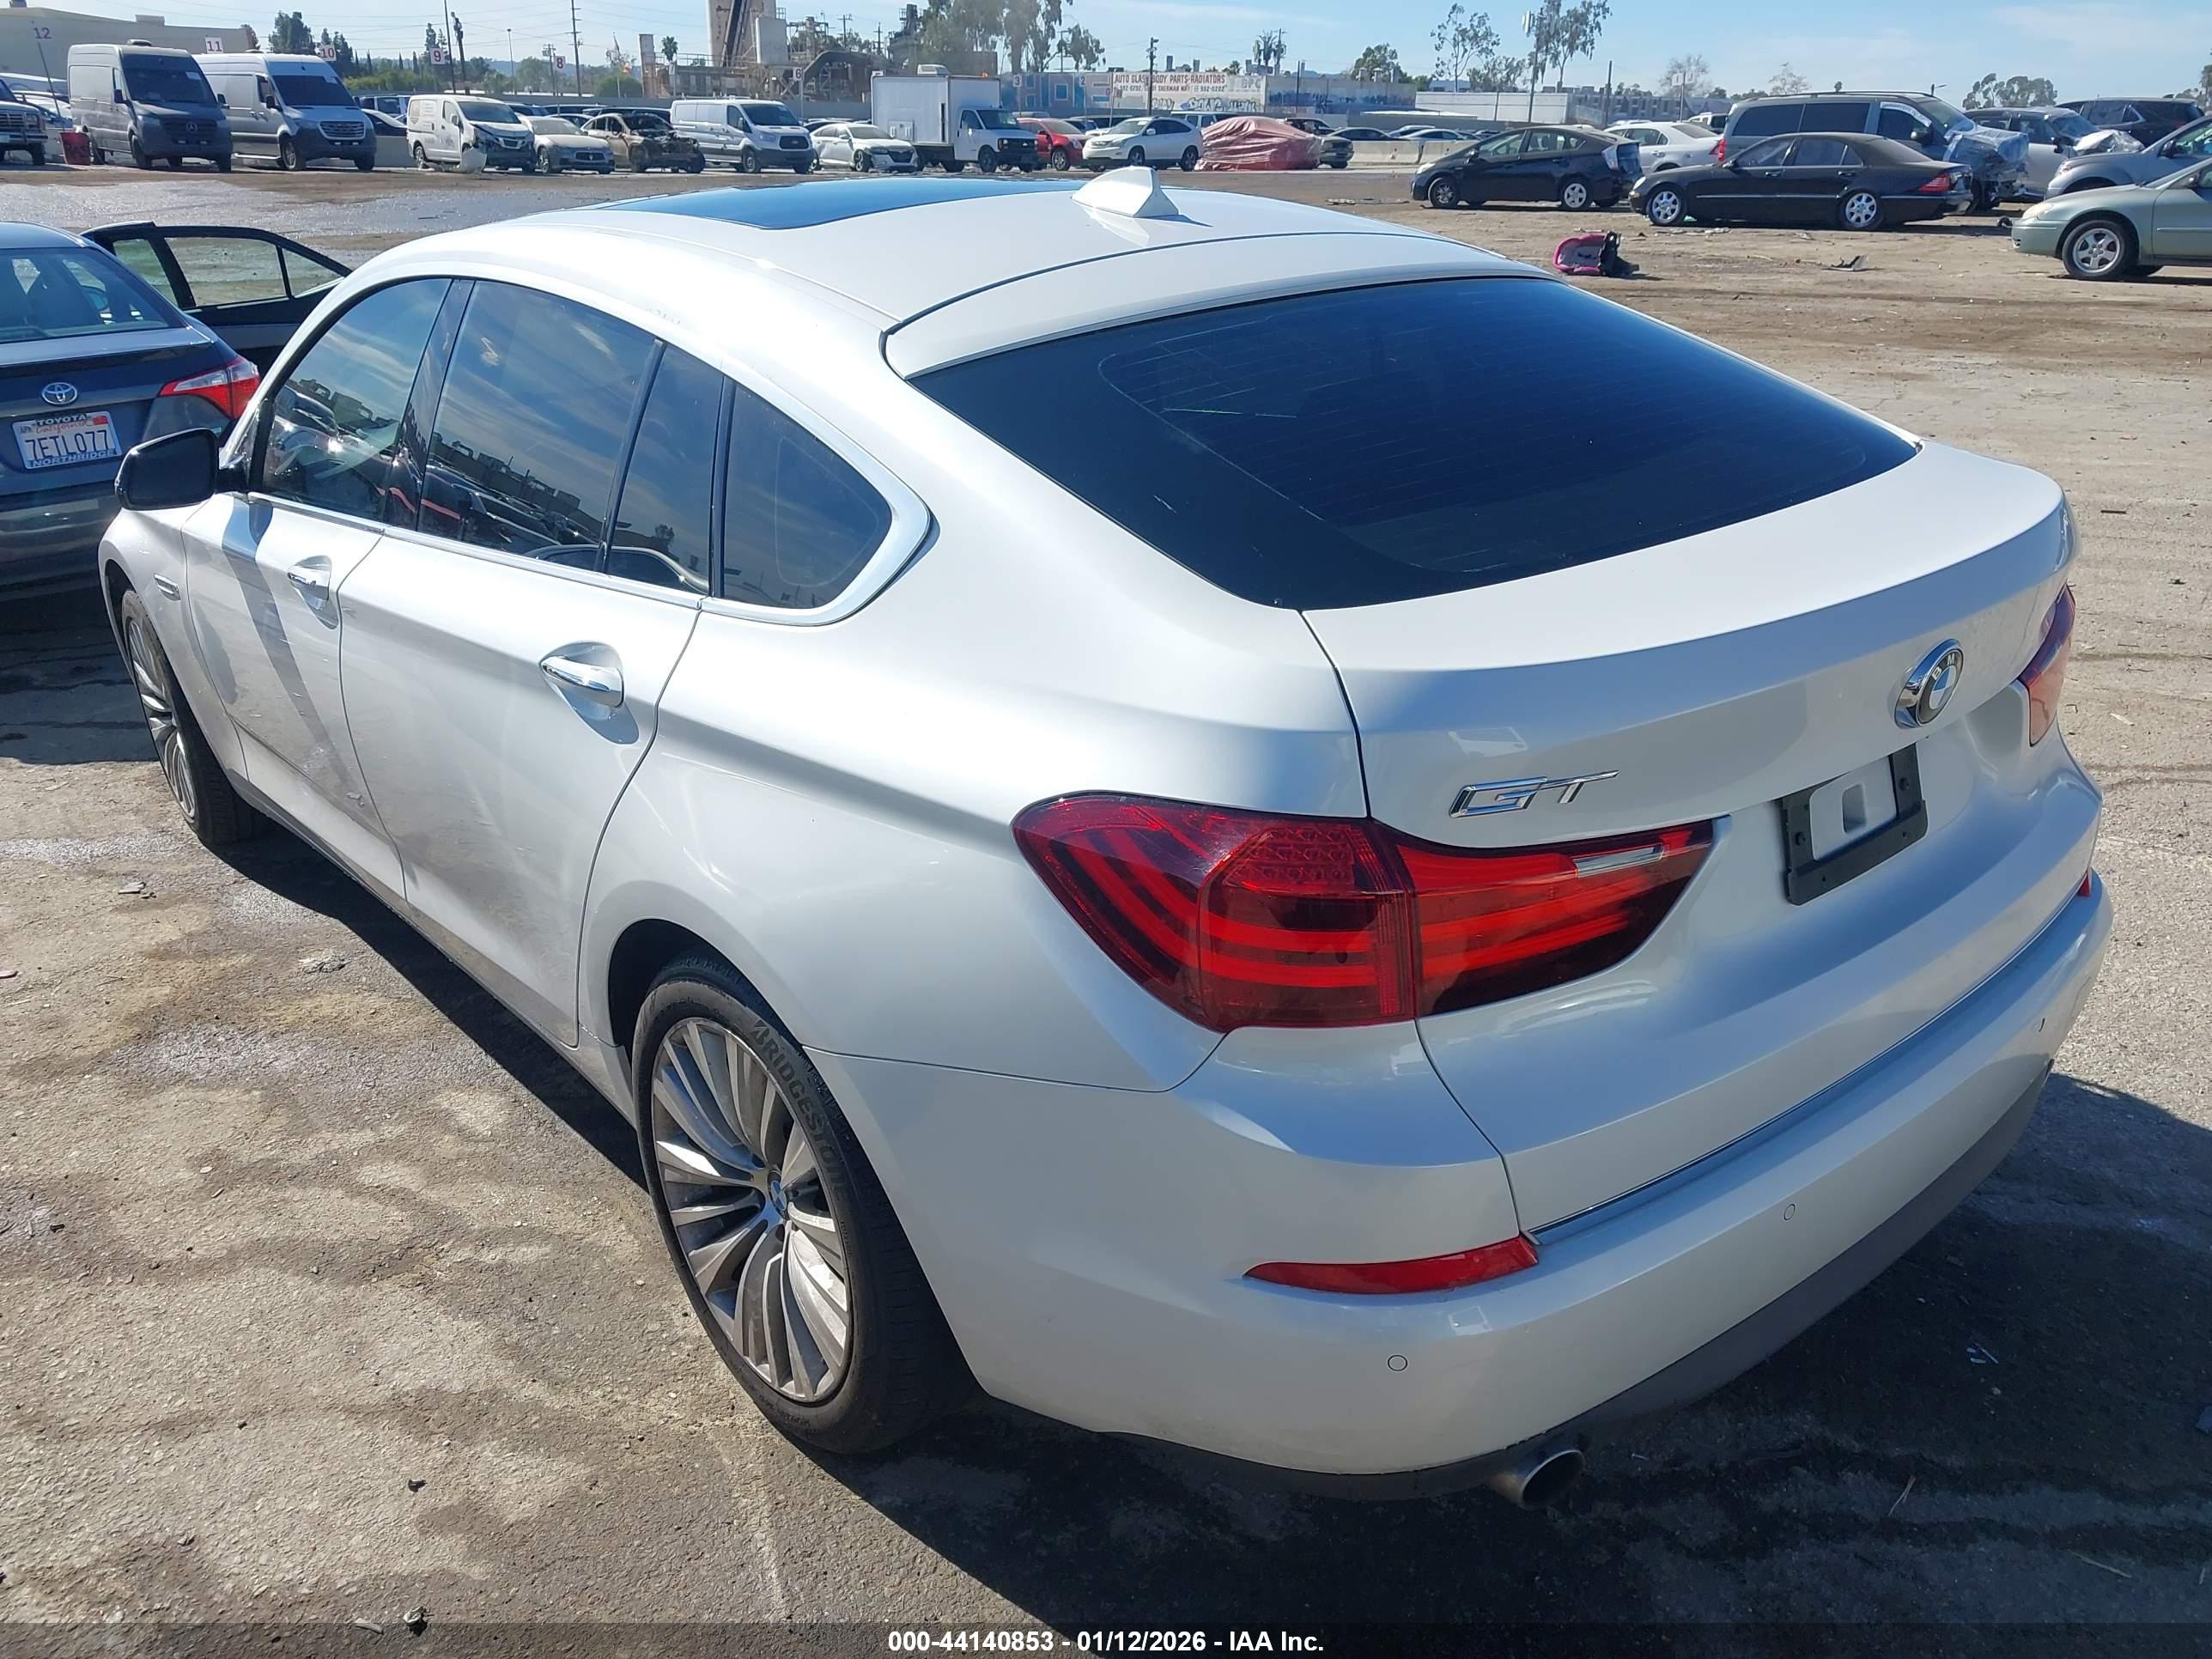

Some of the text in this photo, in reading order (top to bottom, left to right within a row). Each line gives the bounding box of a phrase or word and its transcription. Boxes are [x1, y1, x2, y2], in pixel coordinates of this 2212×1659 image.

[33, 27, 52, 39] 12
[207, 40, 222, 52] 11
[321, 47, 334, 58] 10
[433, 50, 441, 62] 9
[556, 57, 564, 69] 8
[795, 68, 802, 79] 6
[1114, 75, 1129, 83] AUTO
[1131, 75, 1149, 83] GLAS
[1014, 76, 1021, 86] 3
[1080, 76, 1086, 85] 2
[37, 414, 87, 426] TOYOTA
[25, 429, 109, 460] 7ETL077
[1449, 769, 1620, 818] GT
[750, 1019, 847, 1201] BRIDGESTO
